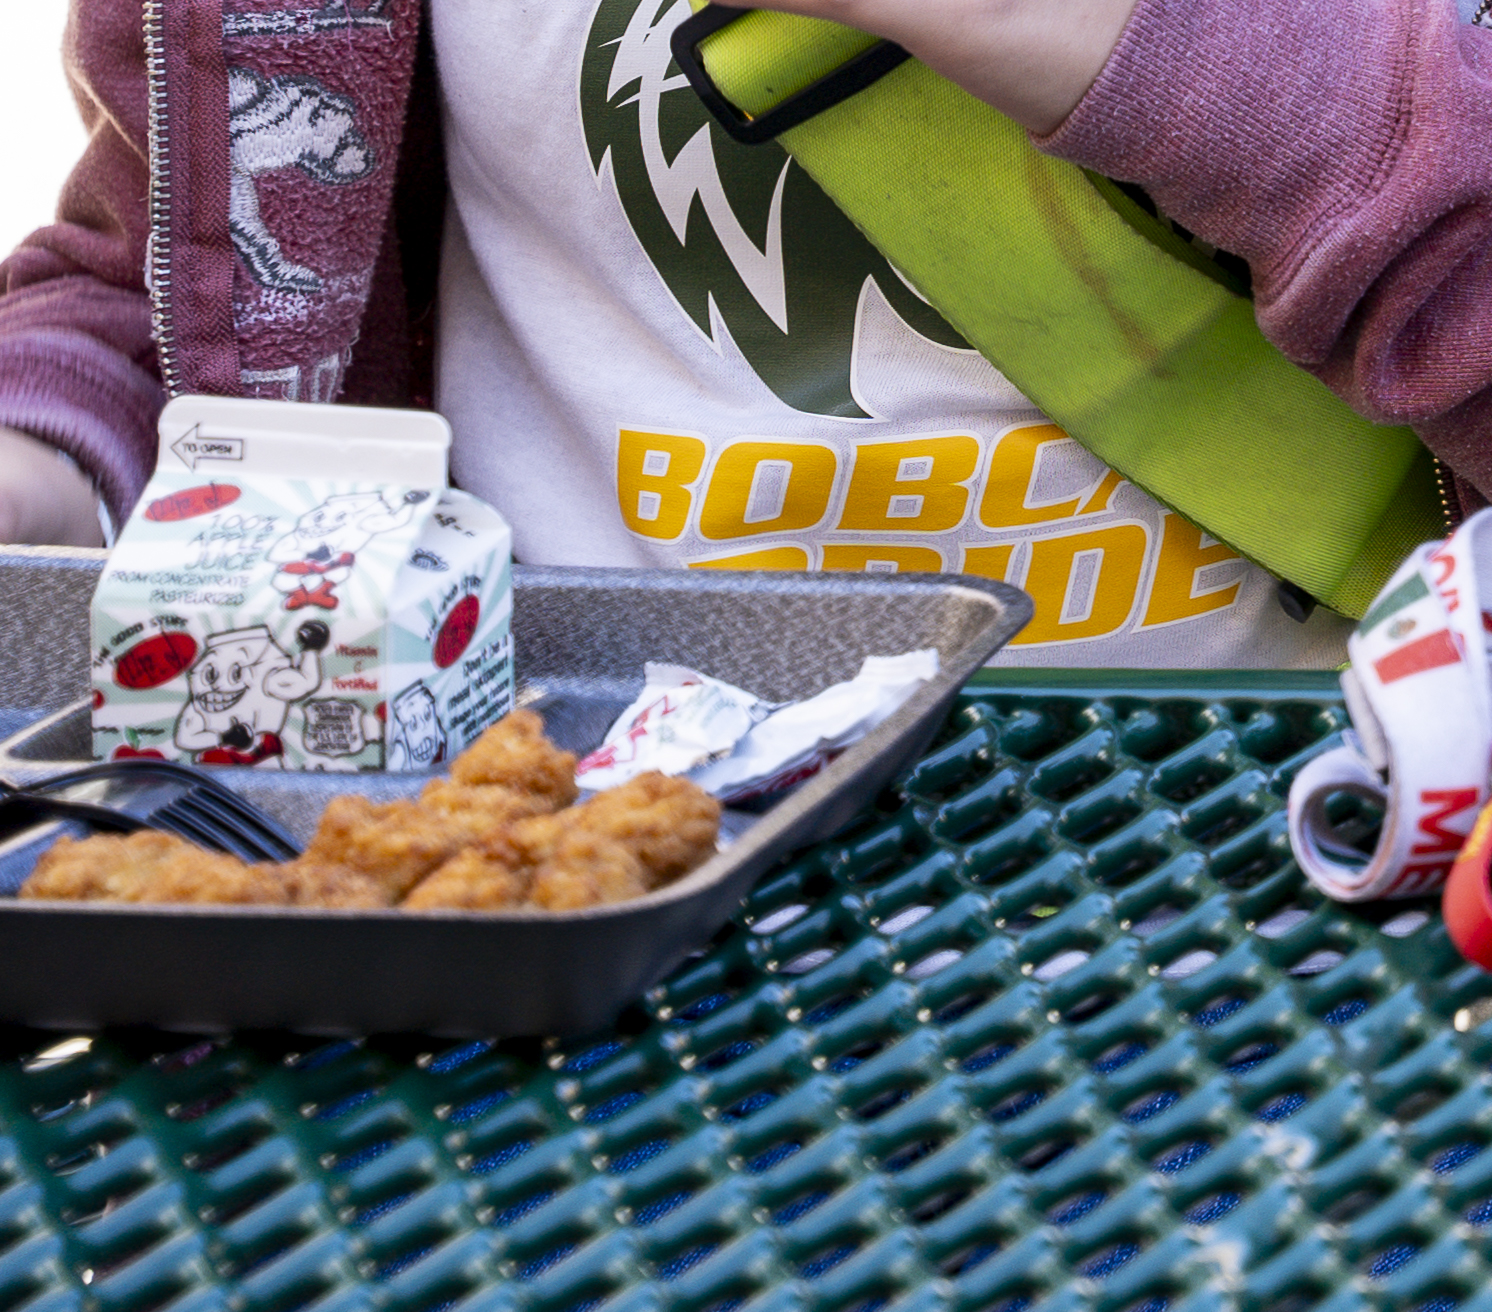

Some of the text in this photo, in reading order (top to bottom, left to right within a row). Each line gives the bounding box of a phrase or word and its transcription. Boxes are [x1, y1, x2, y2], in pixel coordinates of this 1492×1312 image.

[188, 533, 267, 550] APPLE
[183, 552, 259, 570] JUICE
[150, 589, 245, 605] PASTEURIZED
